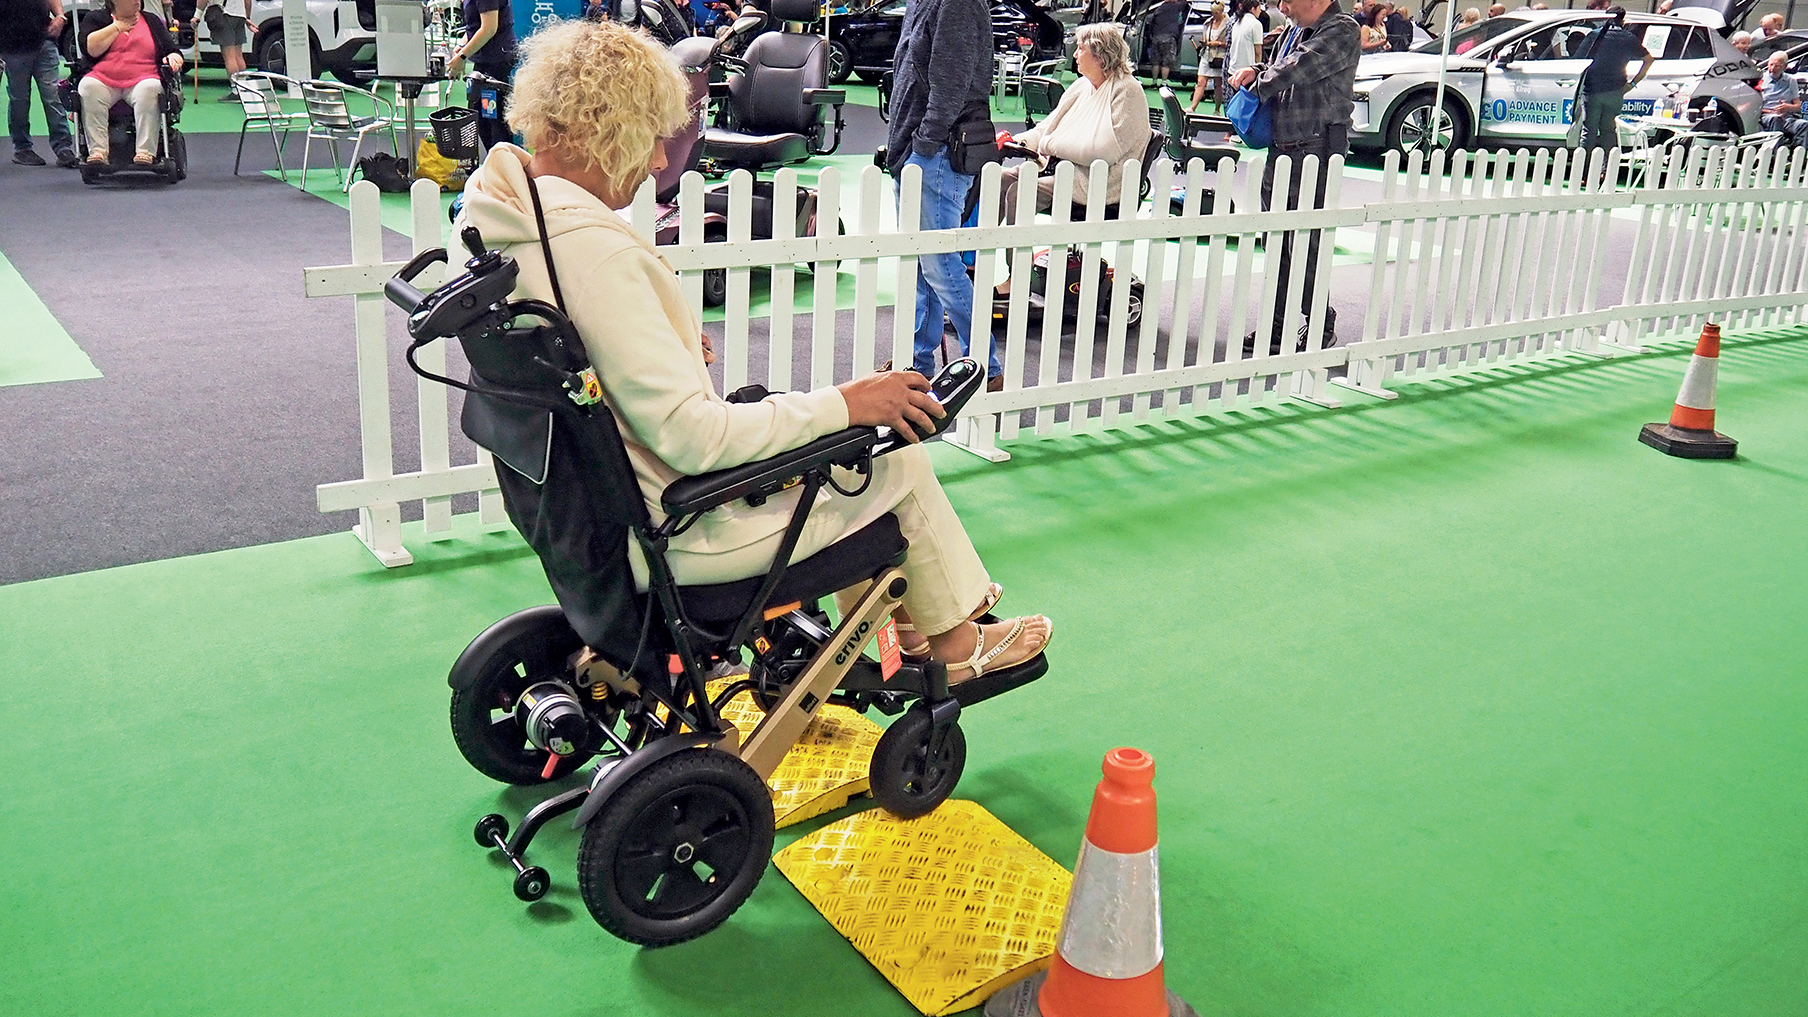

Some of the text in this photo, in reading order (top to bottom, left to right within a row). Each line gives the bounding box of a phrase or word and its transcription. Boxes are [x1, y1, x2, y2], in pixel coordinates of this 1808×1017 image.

[1481, 98, 1507, 122] £0
[1509, 101, 1557, 112] ADVANCE
[1622, 101, 1652, 114] ability
[1509, 113, 1556, 124] PAYMENT
[835, 621, 870, 665] erivo
